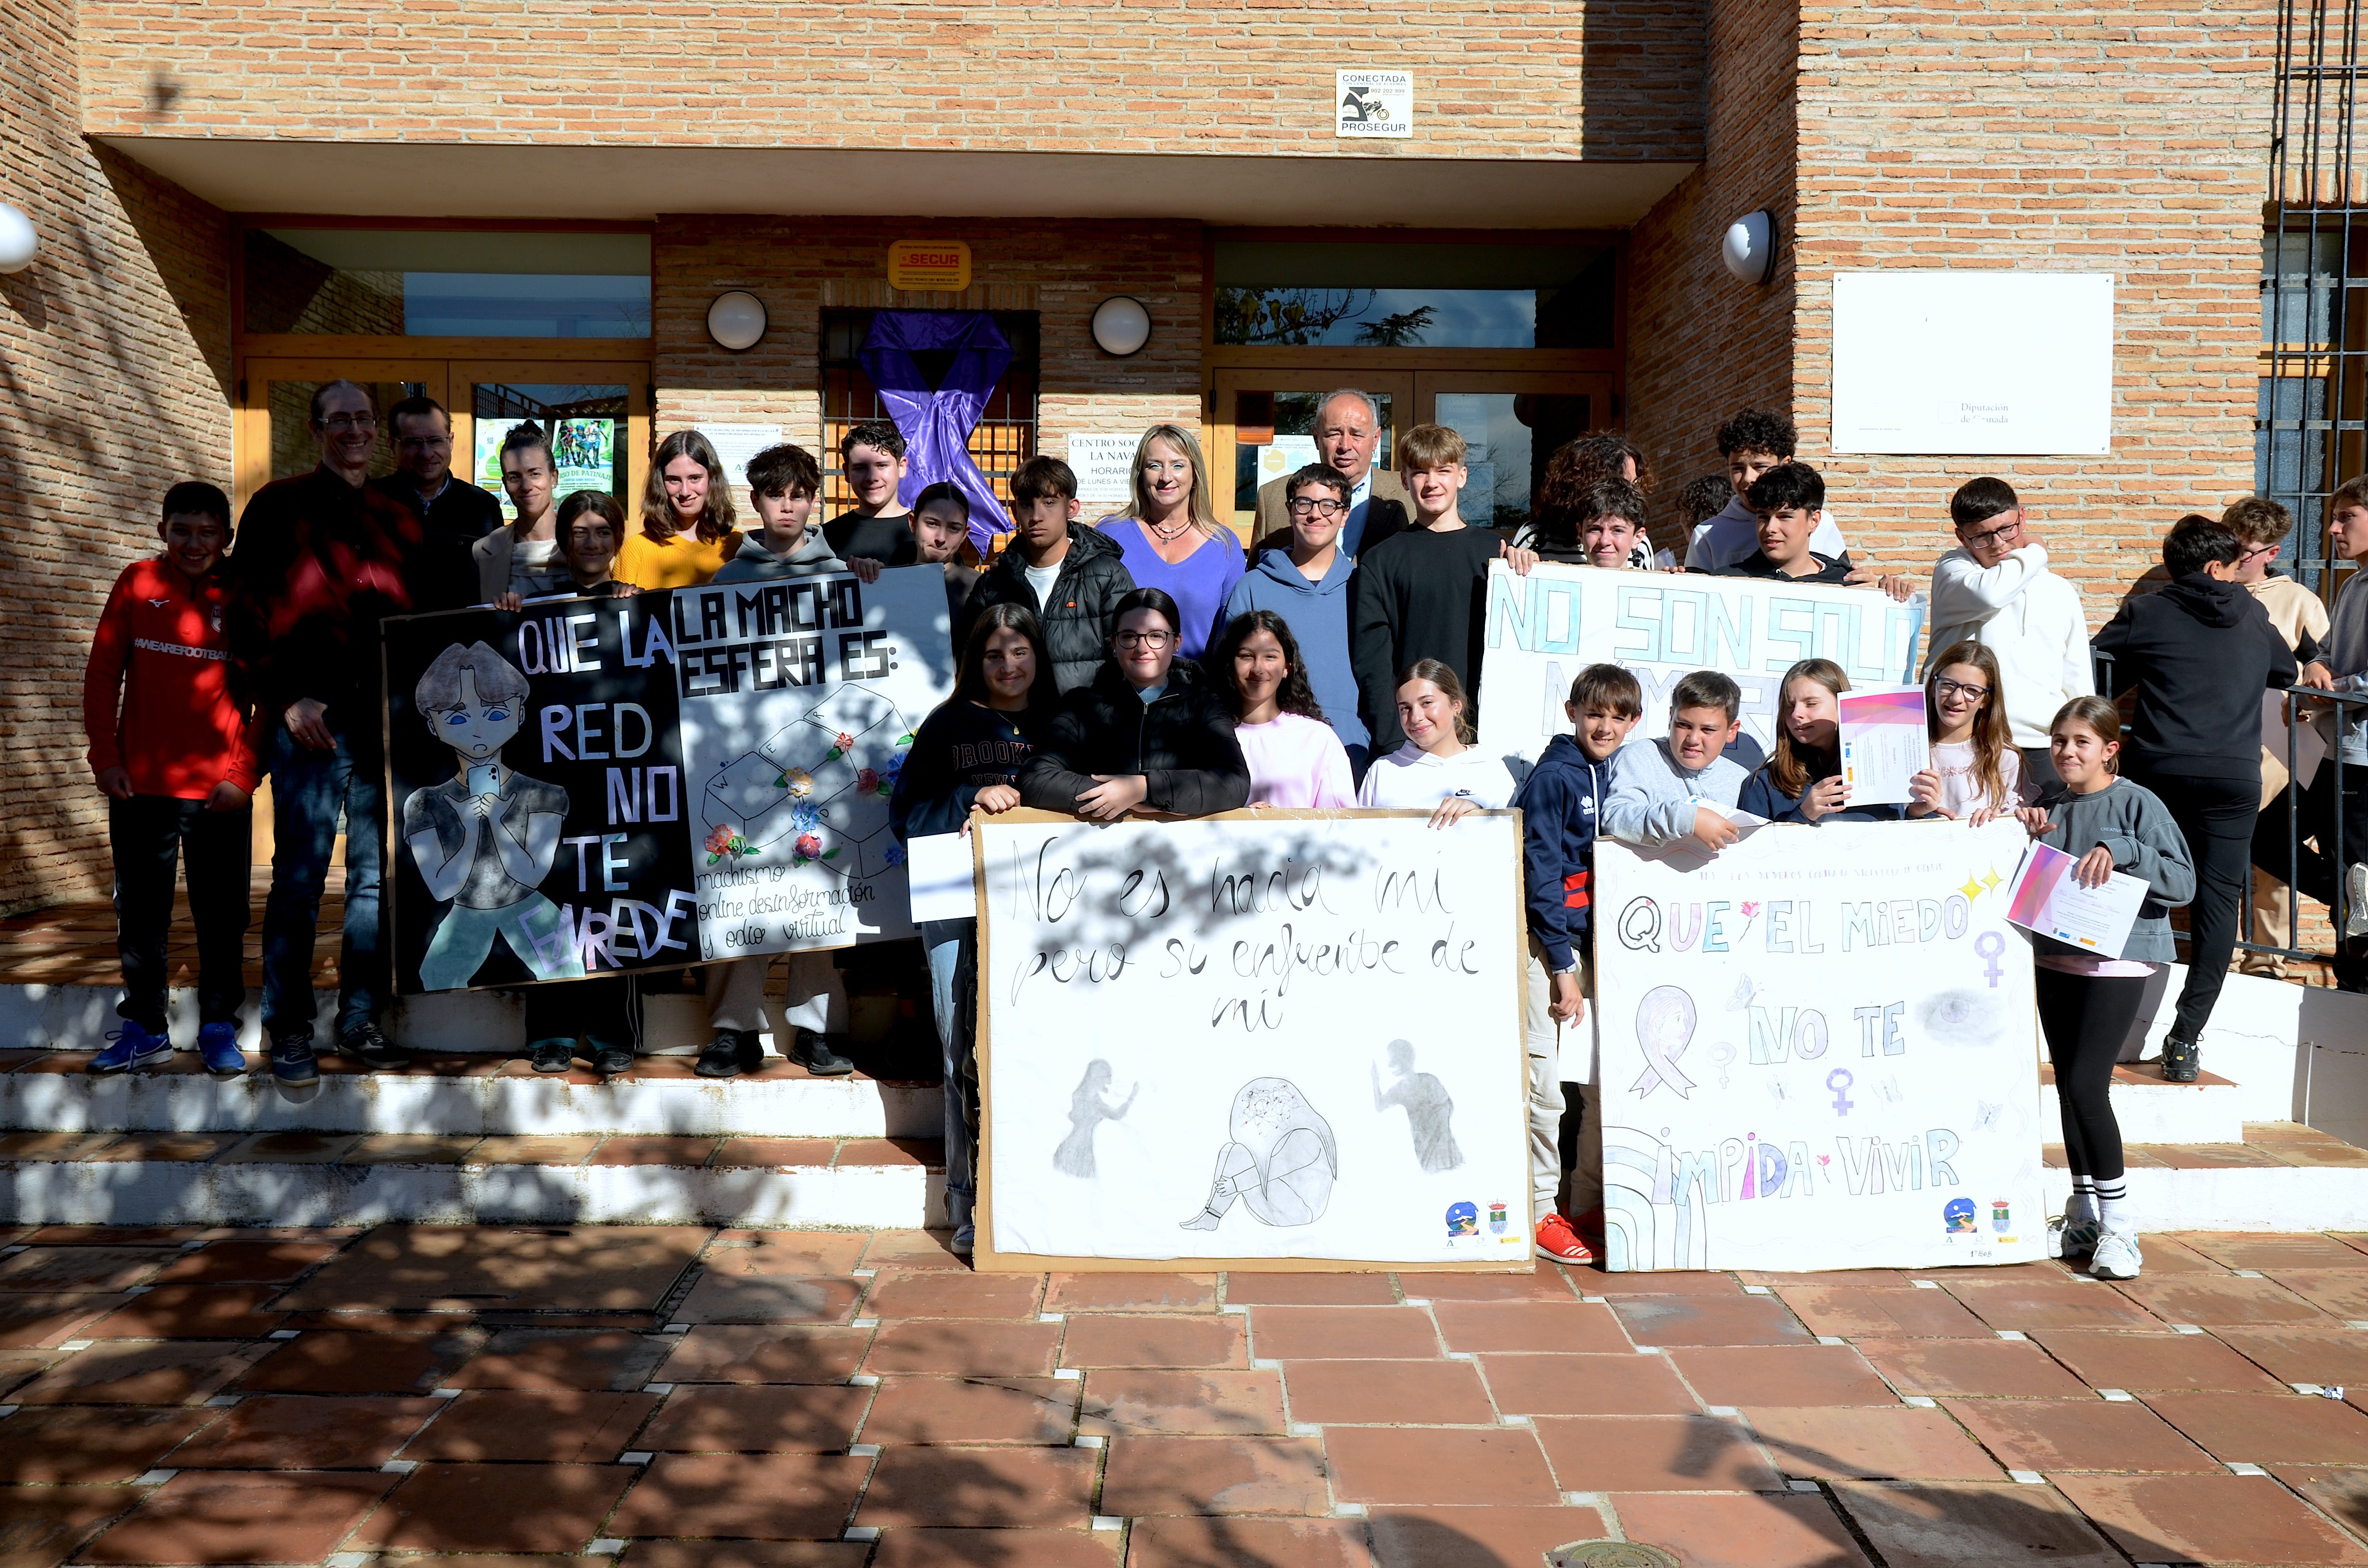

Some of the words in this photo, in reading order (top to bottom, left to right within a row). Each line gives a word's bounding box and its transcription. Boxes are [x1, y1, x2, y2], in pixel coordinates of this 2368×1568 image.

[1342, 123, 1406, 132] PROSEGUR
[910, 254, 959, 265] SECUR
[1961, 403, 2009, 412] Diputación
[1072, 439, 1115, 447] CENTRO
[1118, 439, 1139, 447] SOC
[1090, 452, 1104, 460] LA
[581, 470, 612, 481] PATINAJE
[673, 593, 726, 645] LA
[736, 578, 865, 638] MACHO
[1488, 574, 1581, 655] NO
[1614, 585, 1752, 669] SON
[518, 613, 602, 674] QUE
[618, 611, 675, 668] LA
[678, 635, 826, 698] ESFERA
[838, 629, 898, 681] ES:
[540, 702, 653, 763] RED
[951, 741, 1034, 772] BROOK
[606, 766, 678, 825] NO
[972, 773, 1008, 788] NEW
[563, 833, 629, 892] TE
[696, 860, 785, 891] machismo
[1012, 836, 1088, 923] No
[1120, 868, 1170, 919] es
[1212, 857, 1339, 916] hacia
[749, 882, 875, 915] desinformación
[1617, 895, 1729, 953] QUE
[1766, 900, 1825, 954] EL
[518, 889, 697, 973] ENREDE
[702, 933, 714, 959] y
[726, 919, 765, 948] odio
[783, 906, 846, 940] virtual
[1012, 942, 1135, 1007] pero
[1431, 921, 1479, 975] de
[1748, 1005, 1829, 1065] NO
[1854, 1001, 1905, 1058] TE
